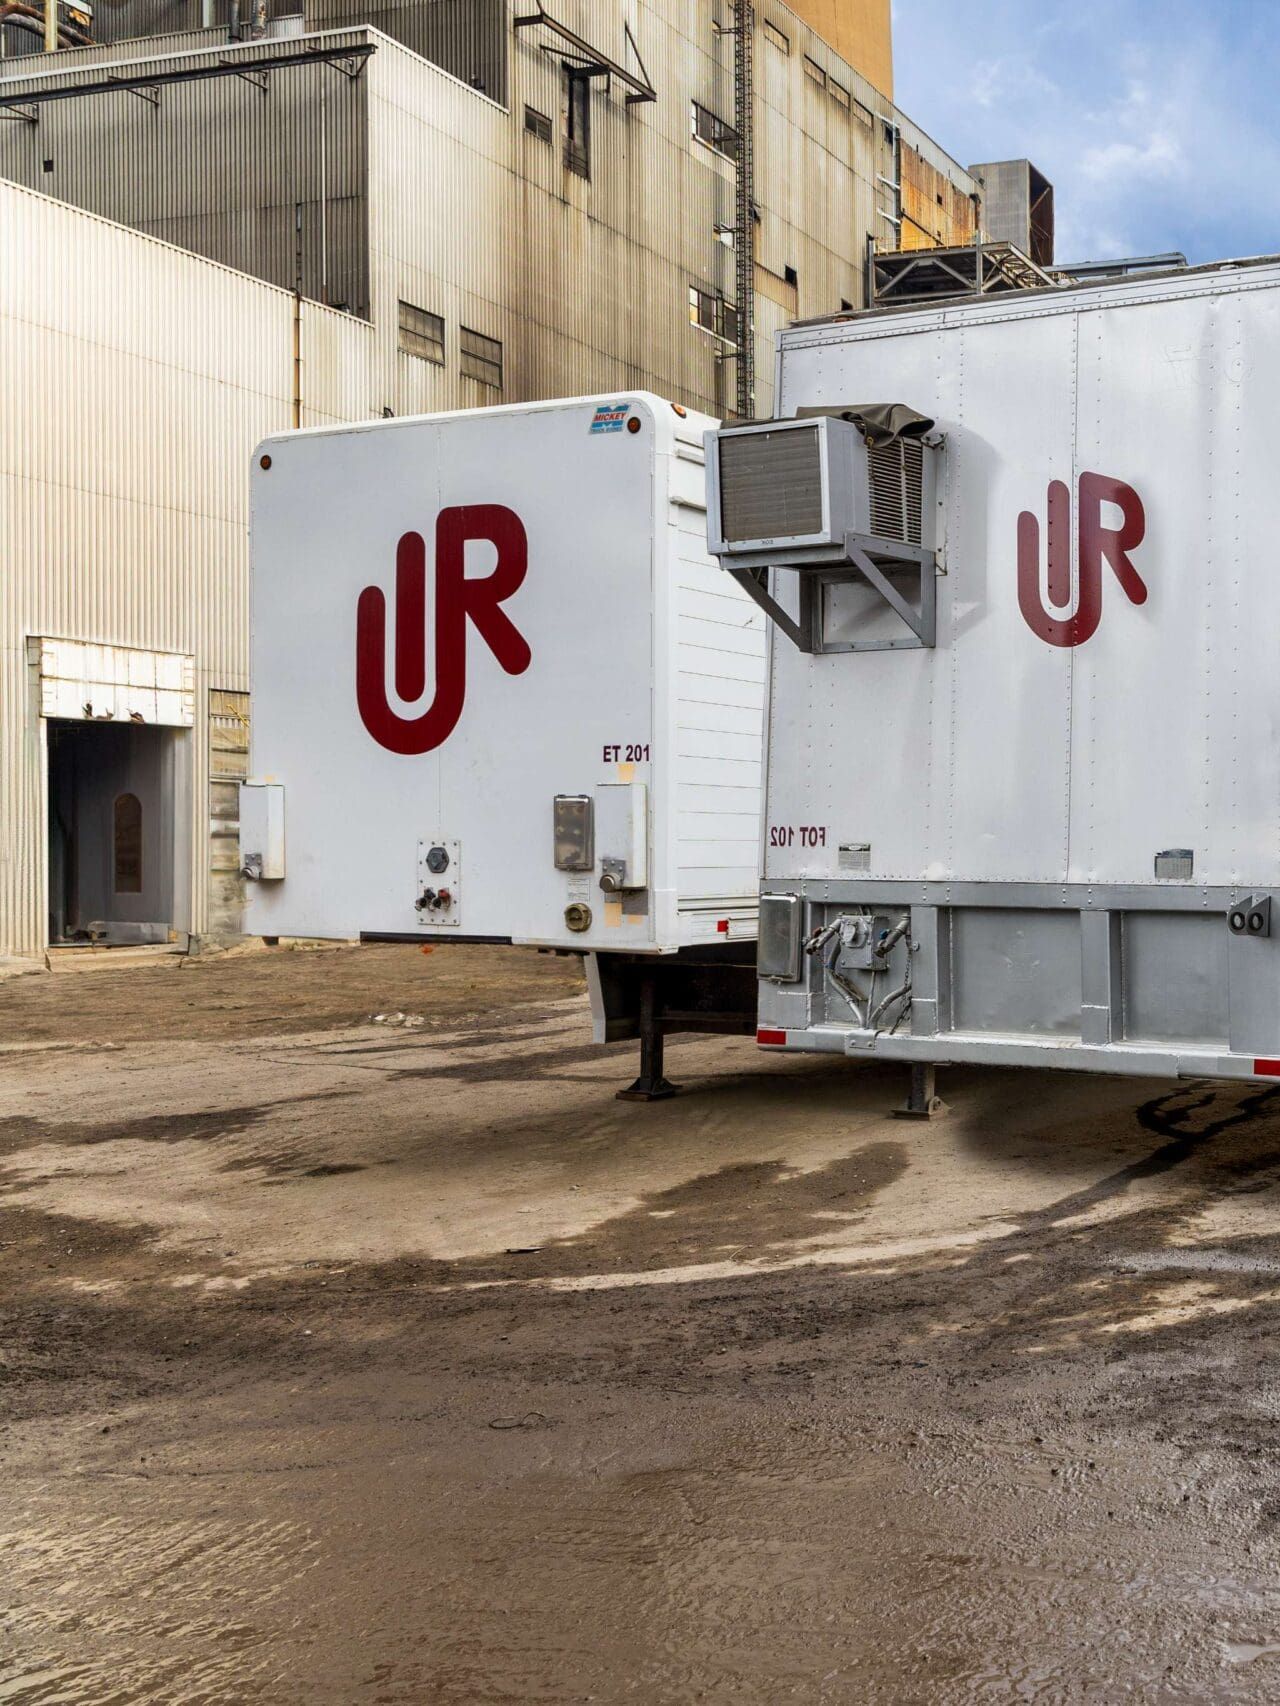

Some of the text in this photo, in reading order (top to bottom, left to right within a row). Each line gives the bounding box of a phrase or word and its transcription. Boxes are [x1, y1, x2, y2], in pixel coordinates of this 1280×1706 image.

[593, 412, 626, 421] MICKEY
[603, 744, 650, 762] ET 201
